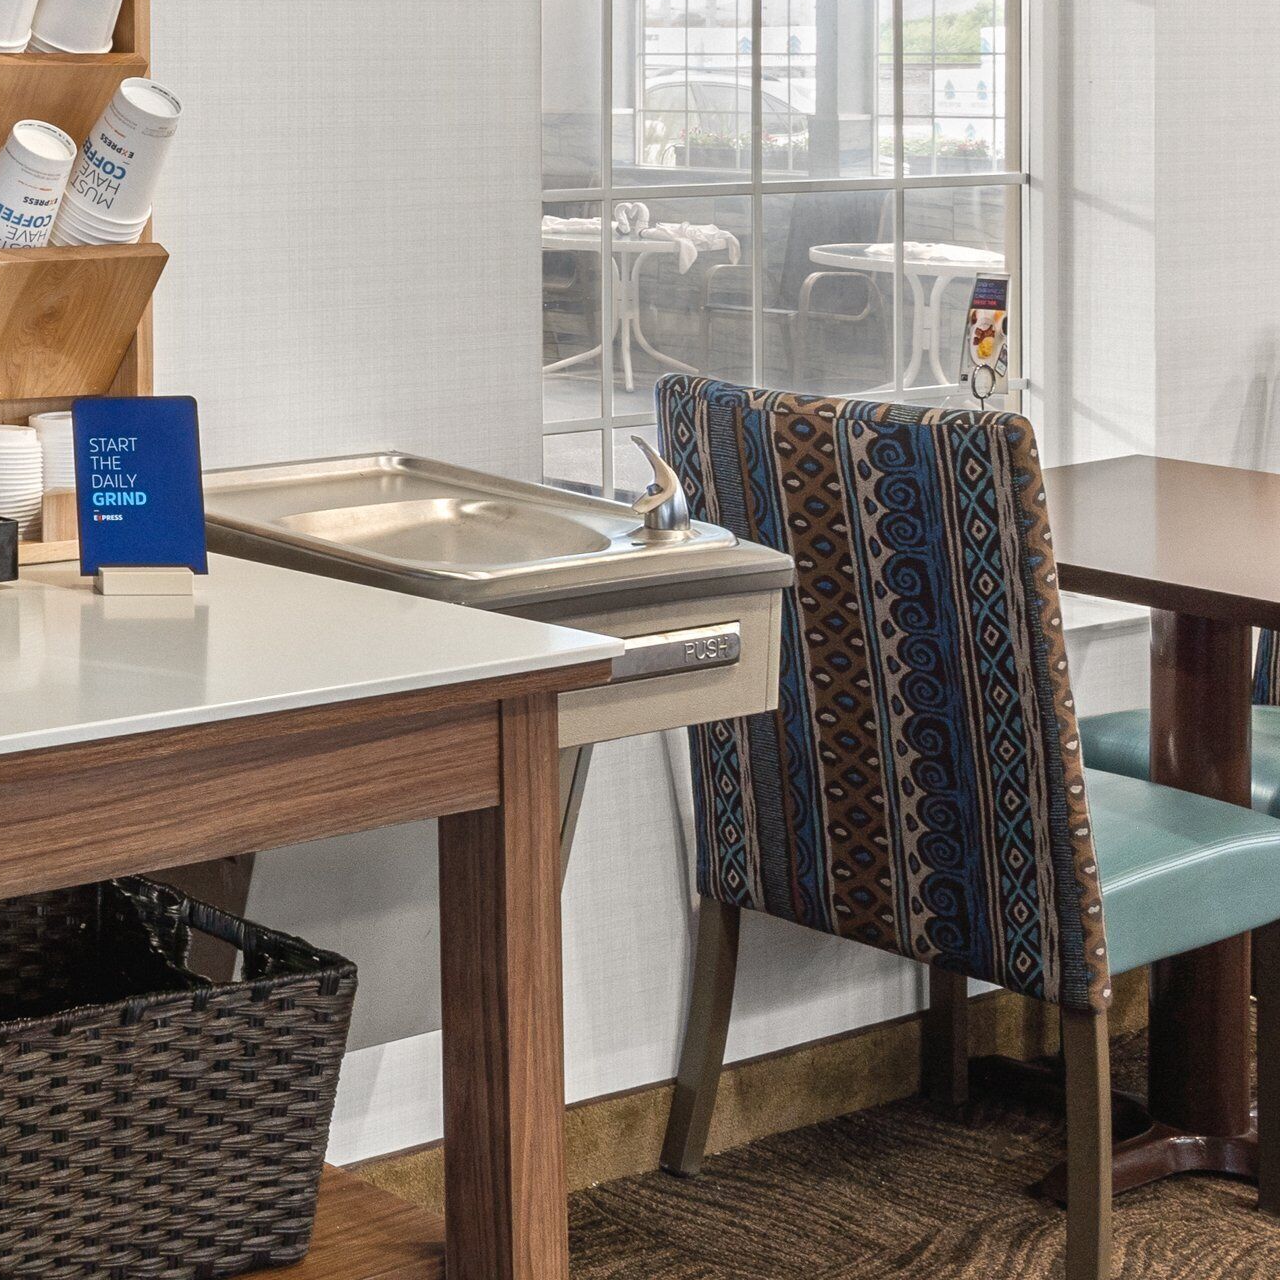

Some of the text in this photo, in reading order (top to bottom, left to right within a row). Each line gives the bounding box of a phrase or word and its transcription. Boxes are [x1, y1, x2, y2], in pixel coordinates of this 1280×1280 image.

[100, 133, 135, 159] EXPRESS
[89, 437, 138, 452] START
[90, 456, 121, 470] THE
[92, 474, 137, 488] DAILY
[92, 491, 147, 506] GRIND
[684, 637, 729, 662] PUSH
